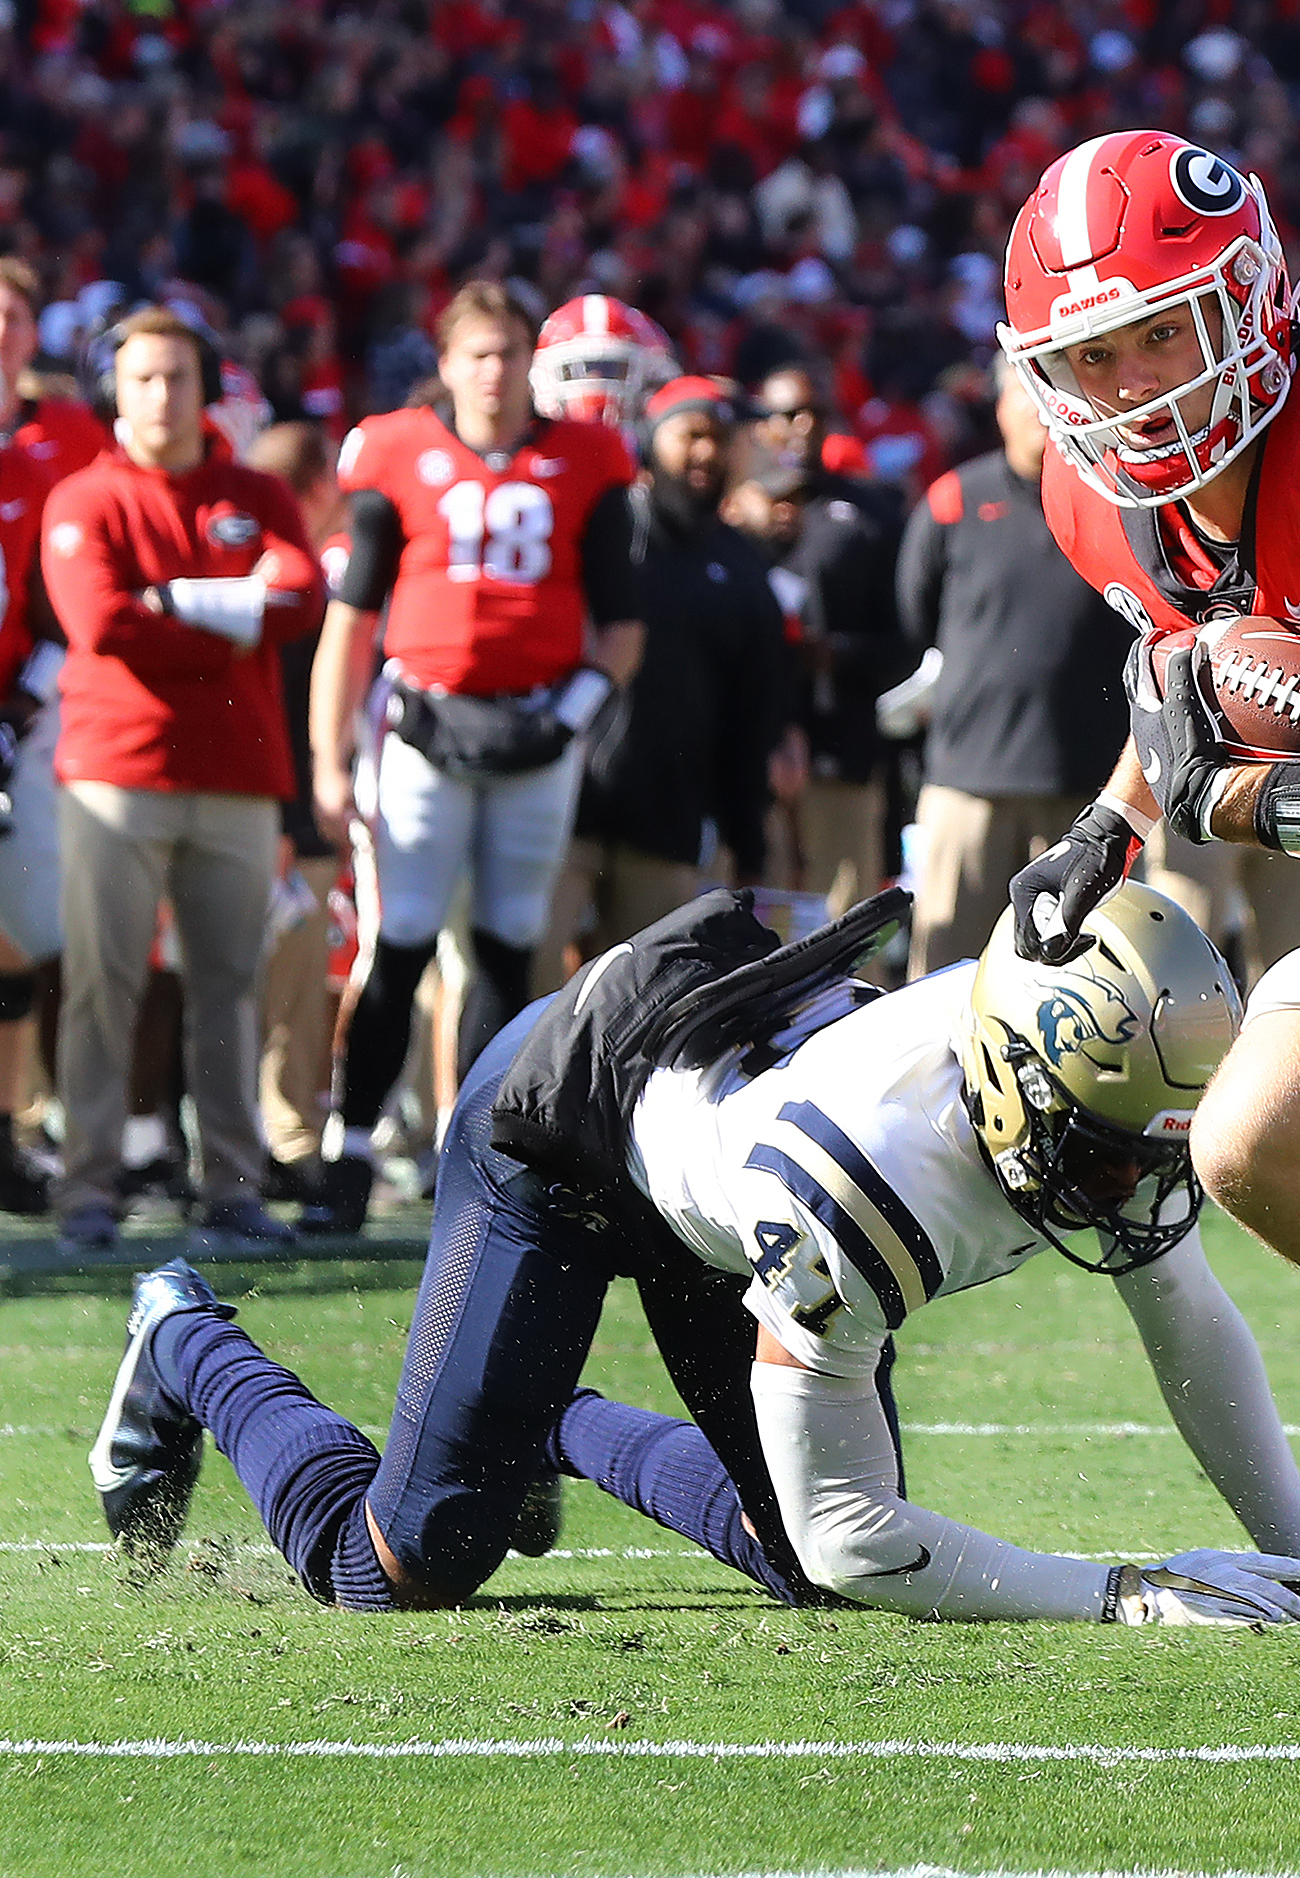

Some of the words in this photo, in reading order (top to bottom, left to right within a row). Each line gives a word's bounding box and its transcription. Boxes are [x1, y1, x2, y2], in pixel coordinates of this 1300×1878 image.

[1059, 287, 1120, 318] DAWGS
[436, 479, 555, 587] 18
[1163, 1117, 1192, 1131] Rid
